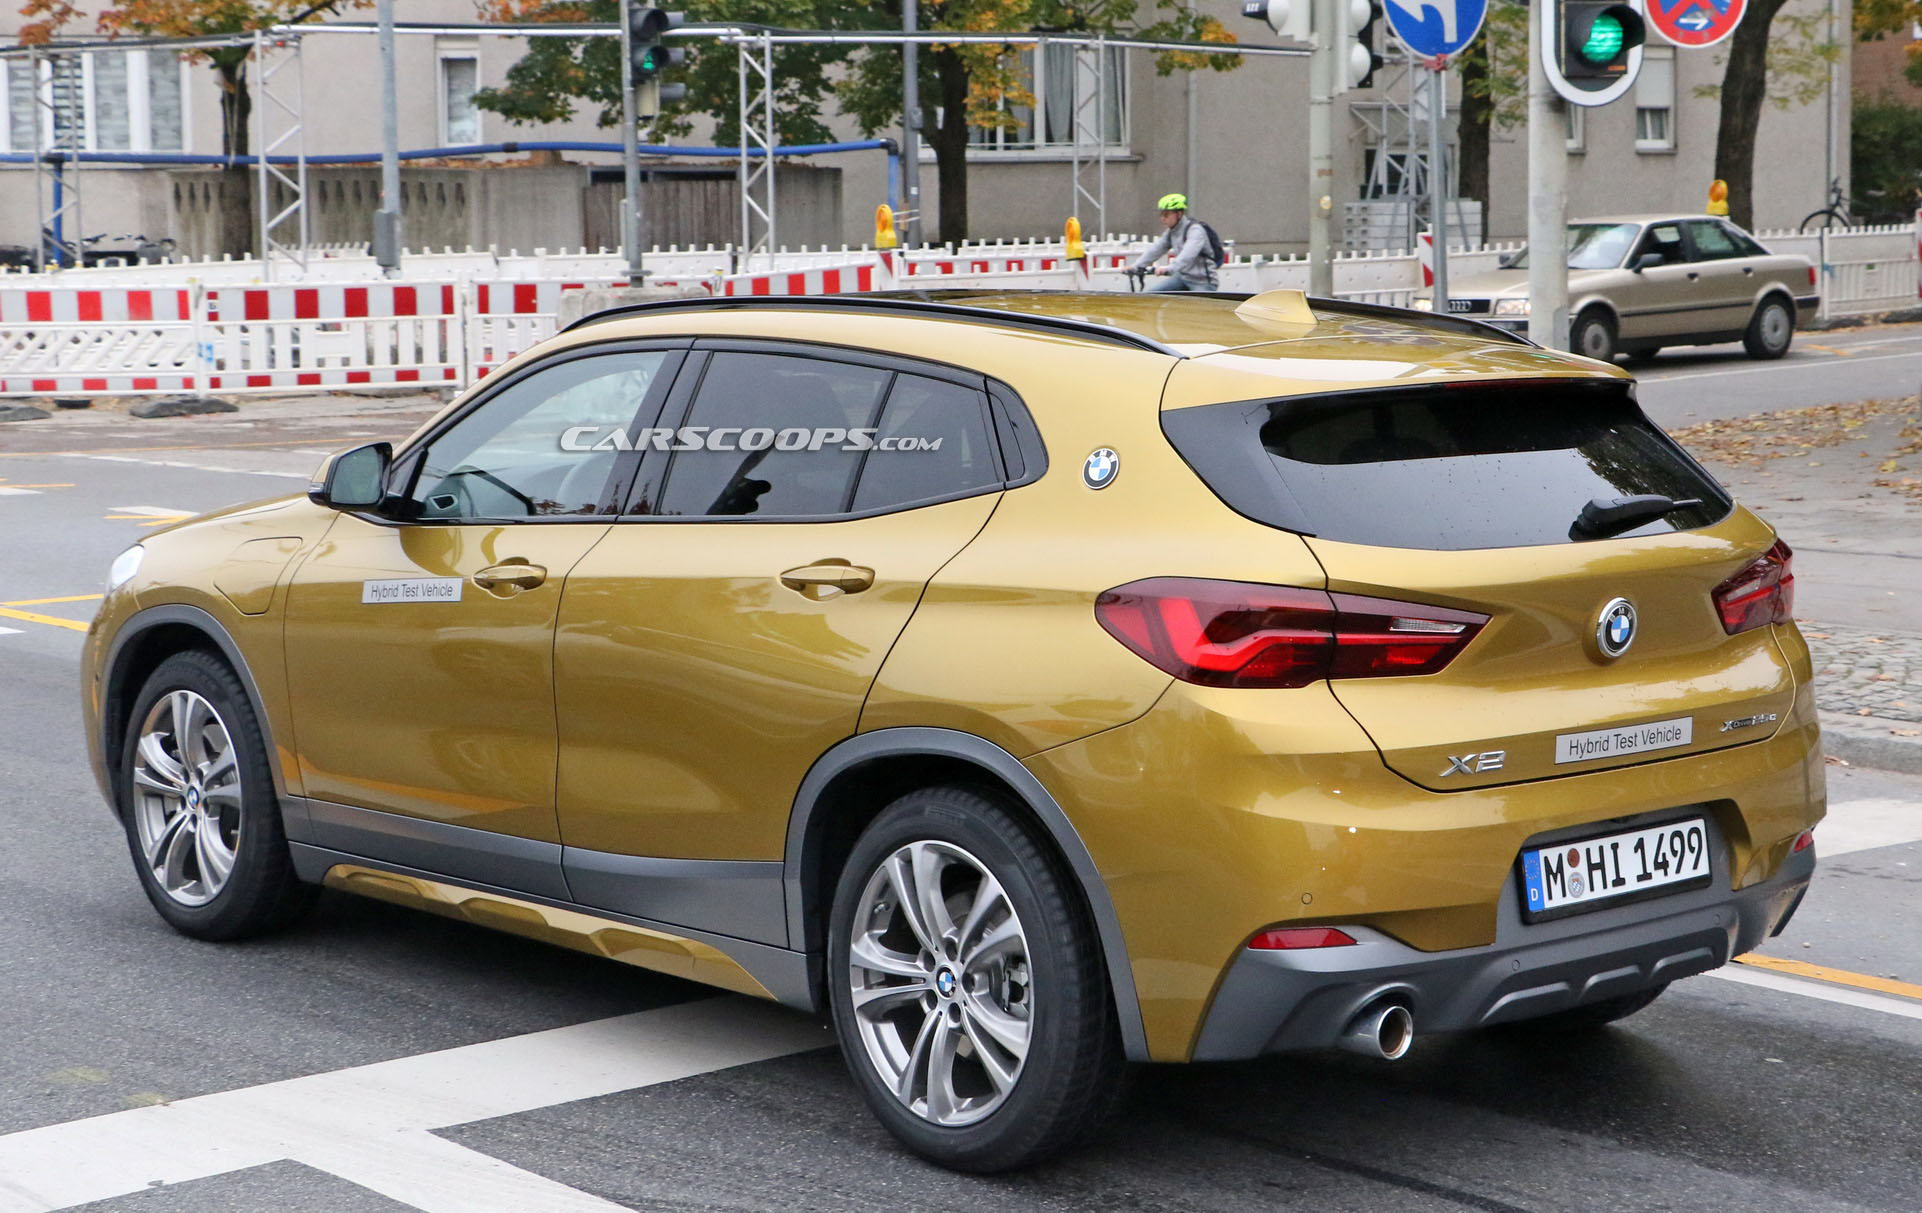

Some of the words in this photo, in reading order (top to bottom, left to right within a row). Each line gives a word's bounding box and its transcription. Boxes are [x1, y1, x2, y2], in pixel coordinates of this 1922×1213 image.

[371, 584, 399, 601] Hybrid
[402, 583, 419, 598] Test
[421, 582, 453, 597] Vehicle
[1569, 735, 1609, 759] Hybrid
[1613, 732, 1638, 750] Test
[1641, 725, 1682, 746] Vehicle
[1439, 751, 1506, 777] X2
[1543, 852, 1567, 900] M
[1585, 842, 1626, 892] HI
[1633, 826, 1703, 883] 1499
[1531, 892, 1539, 902] D
